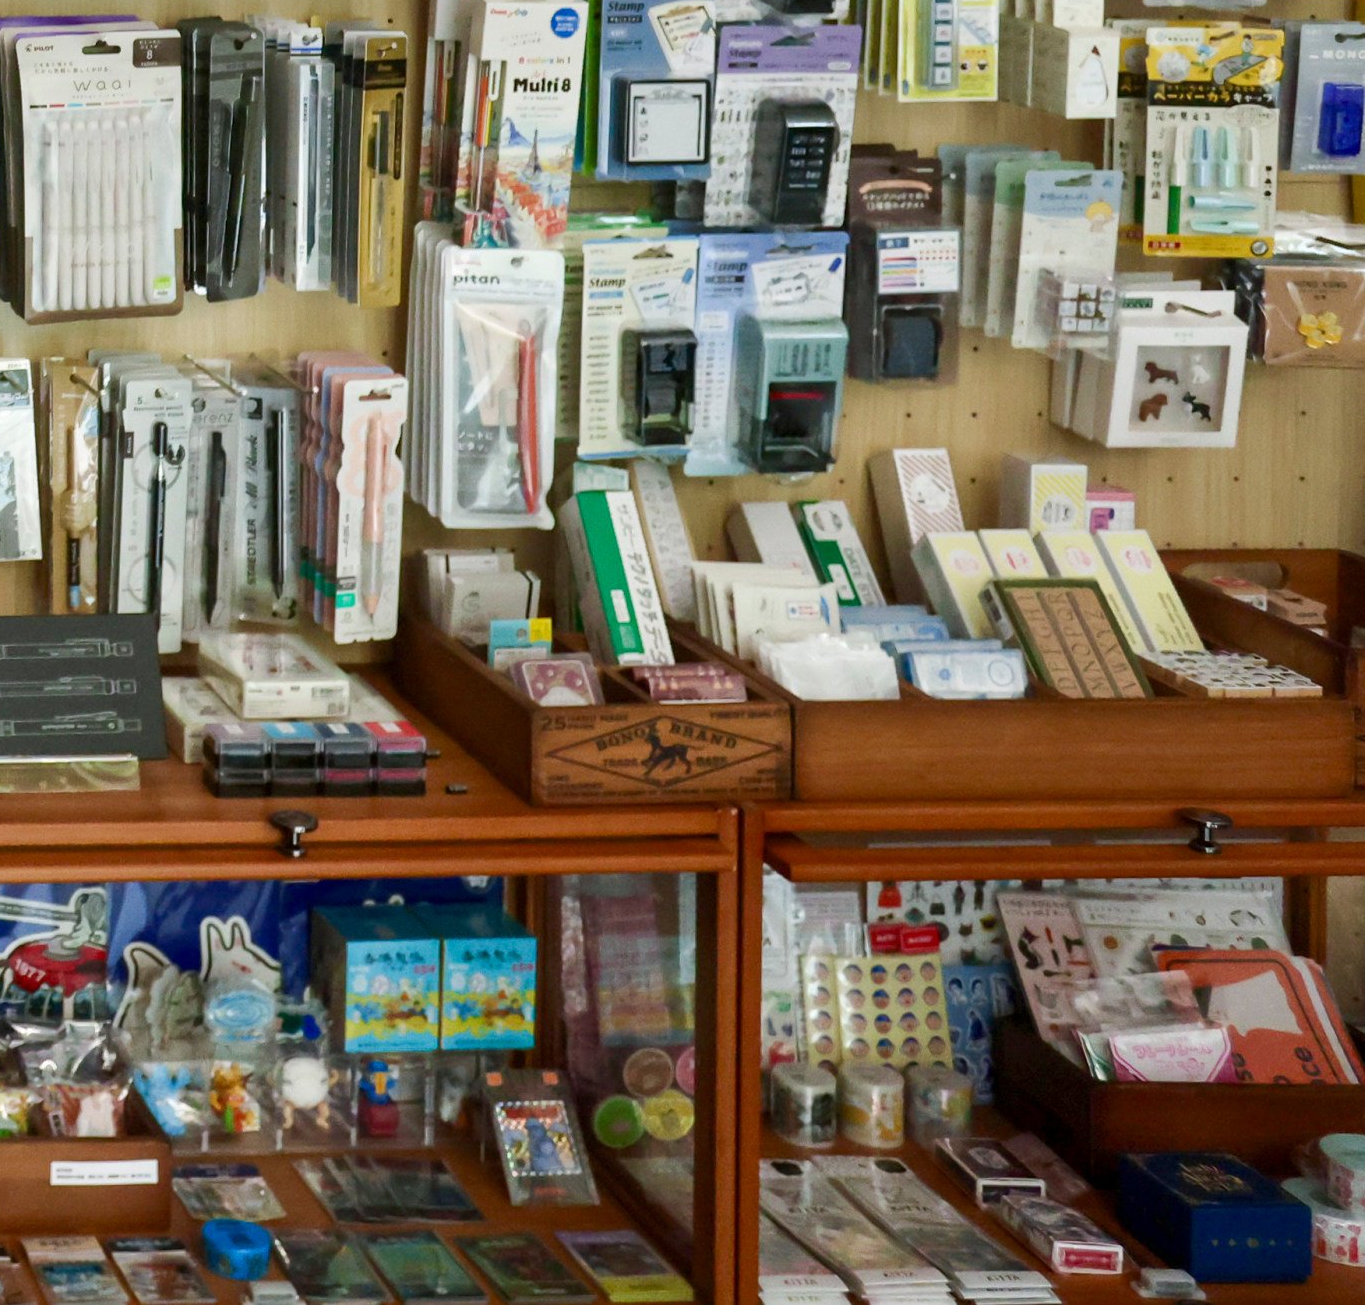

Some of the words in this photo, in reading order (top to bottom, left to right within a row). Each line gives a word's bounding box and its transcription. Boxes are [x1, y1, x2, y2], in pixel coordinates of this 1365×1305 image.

[608, 0, 645, 14] Stamp
[146, 49, 153, 60] 8
[513, 78, 558, 93] Multi
[561, 78, 571, 93] 8
[453, 271, 500, 286] pitan
[588, 277, 626, 289] Stamp
[246, 519, 257, 585] STAEDTLER
[543, 717, 567, 731] 25
[671, 723, 738, 749] BRAND
